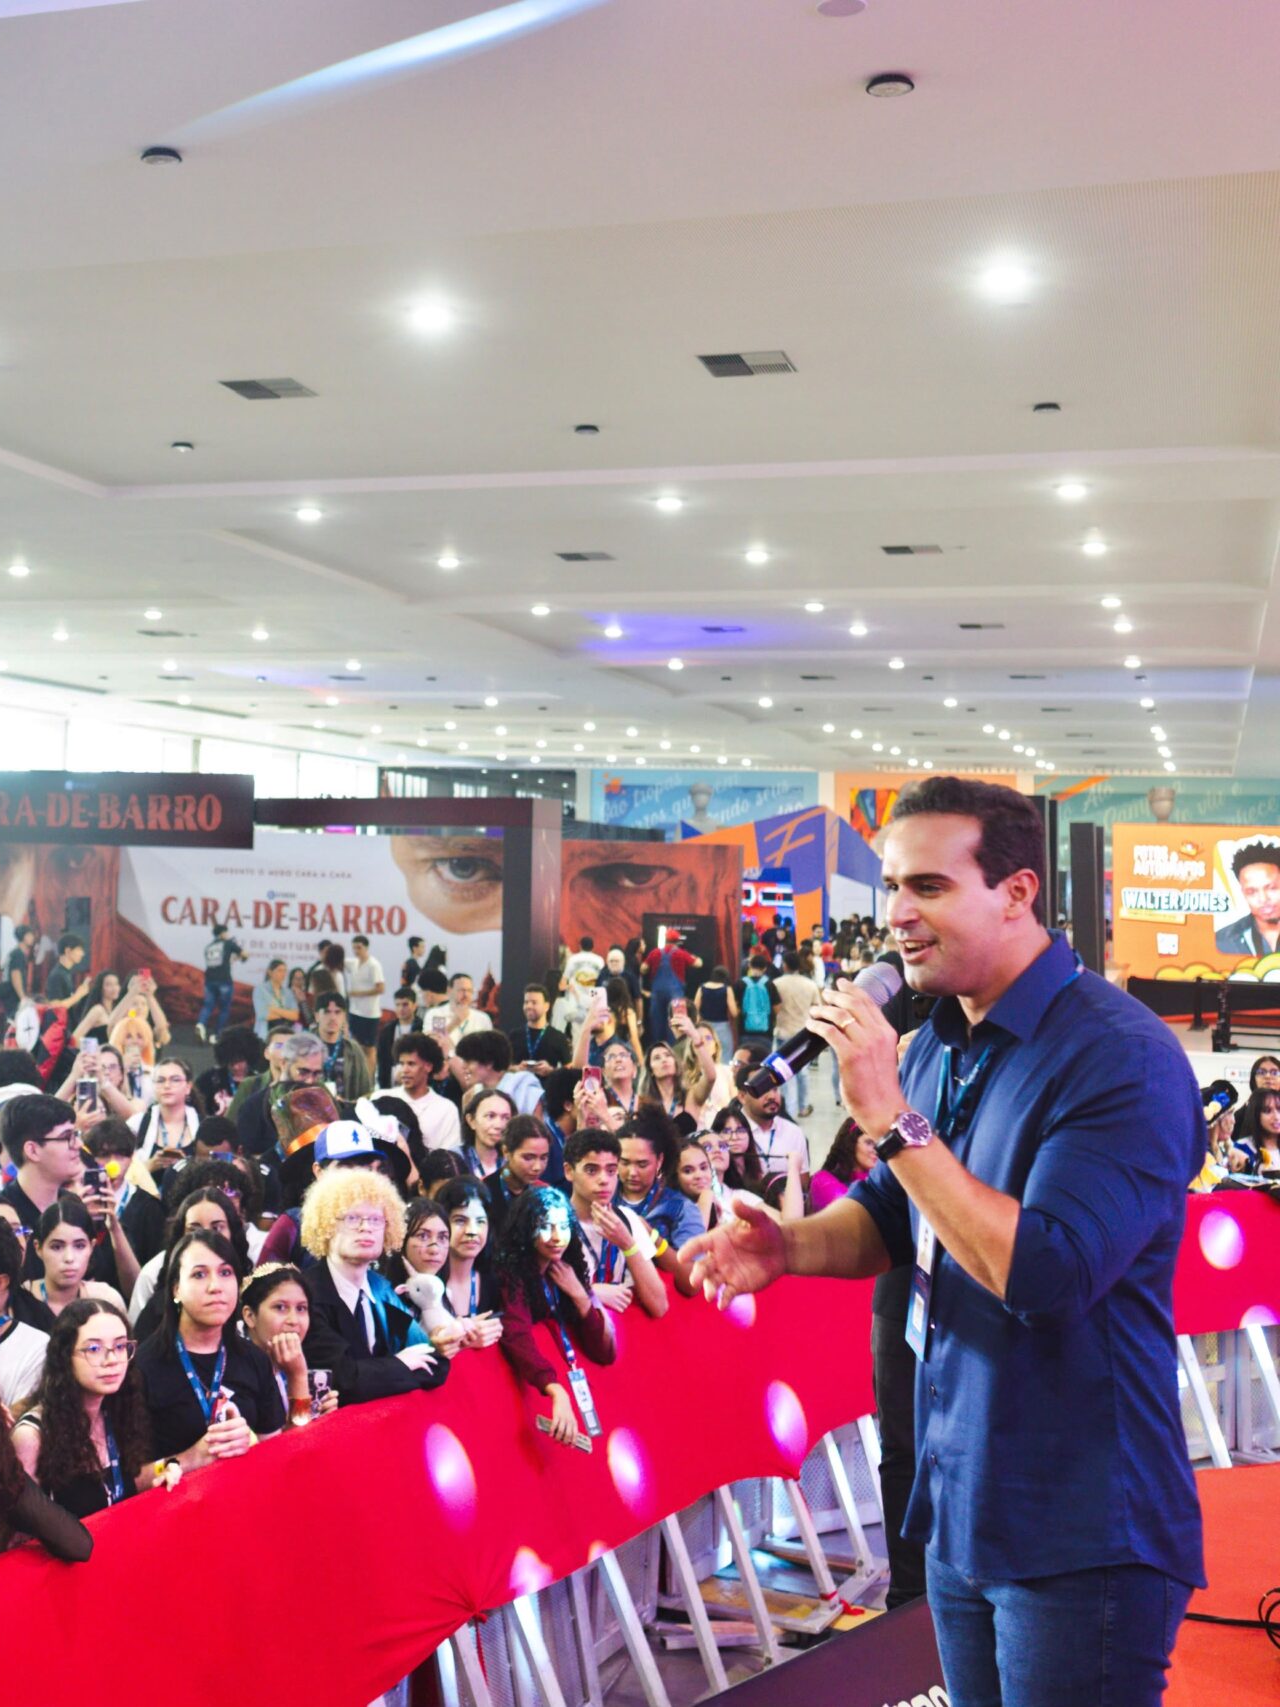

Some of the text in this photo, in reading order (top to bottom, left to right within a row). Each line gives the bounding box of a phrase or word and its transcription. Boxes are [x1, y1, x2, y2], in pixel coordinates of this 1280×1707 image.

[1124, 890, 1230, 913] WALTER JONES
[160, 896, 407, 935] CARA-DE-BARRO
[269, 940, 319, 951] OUTUBR
